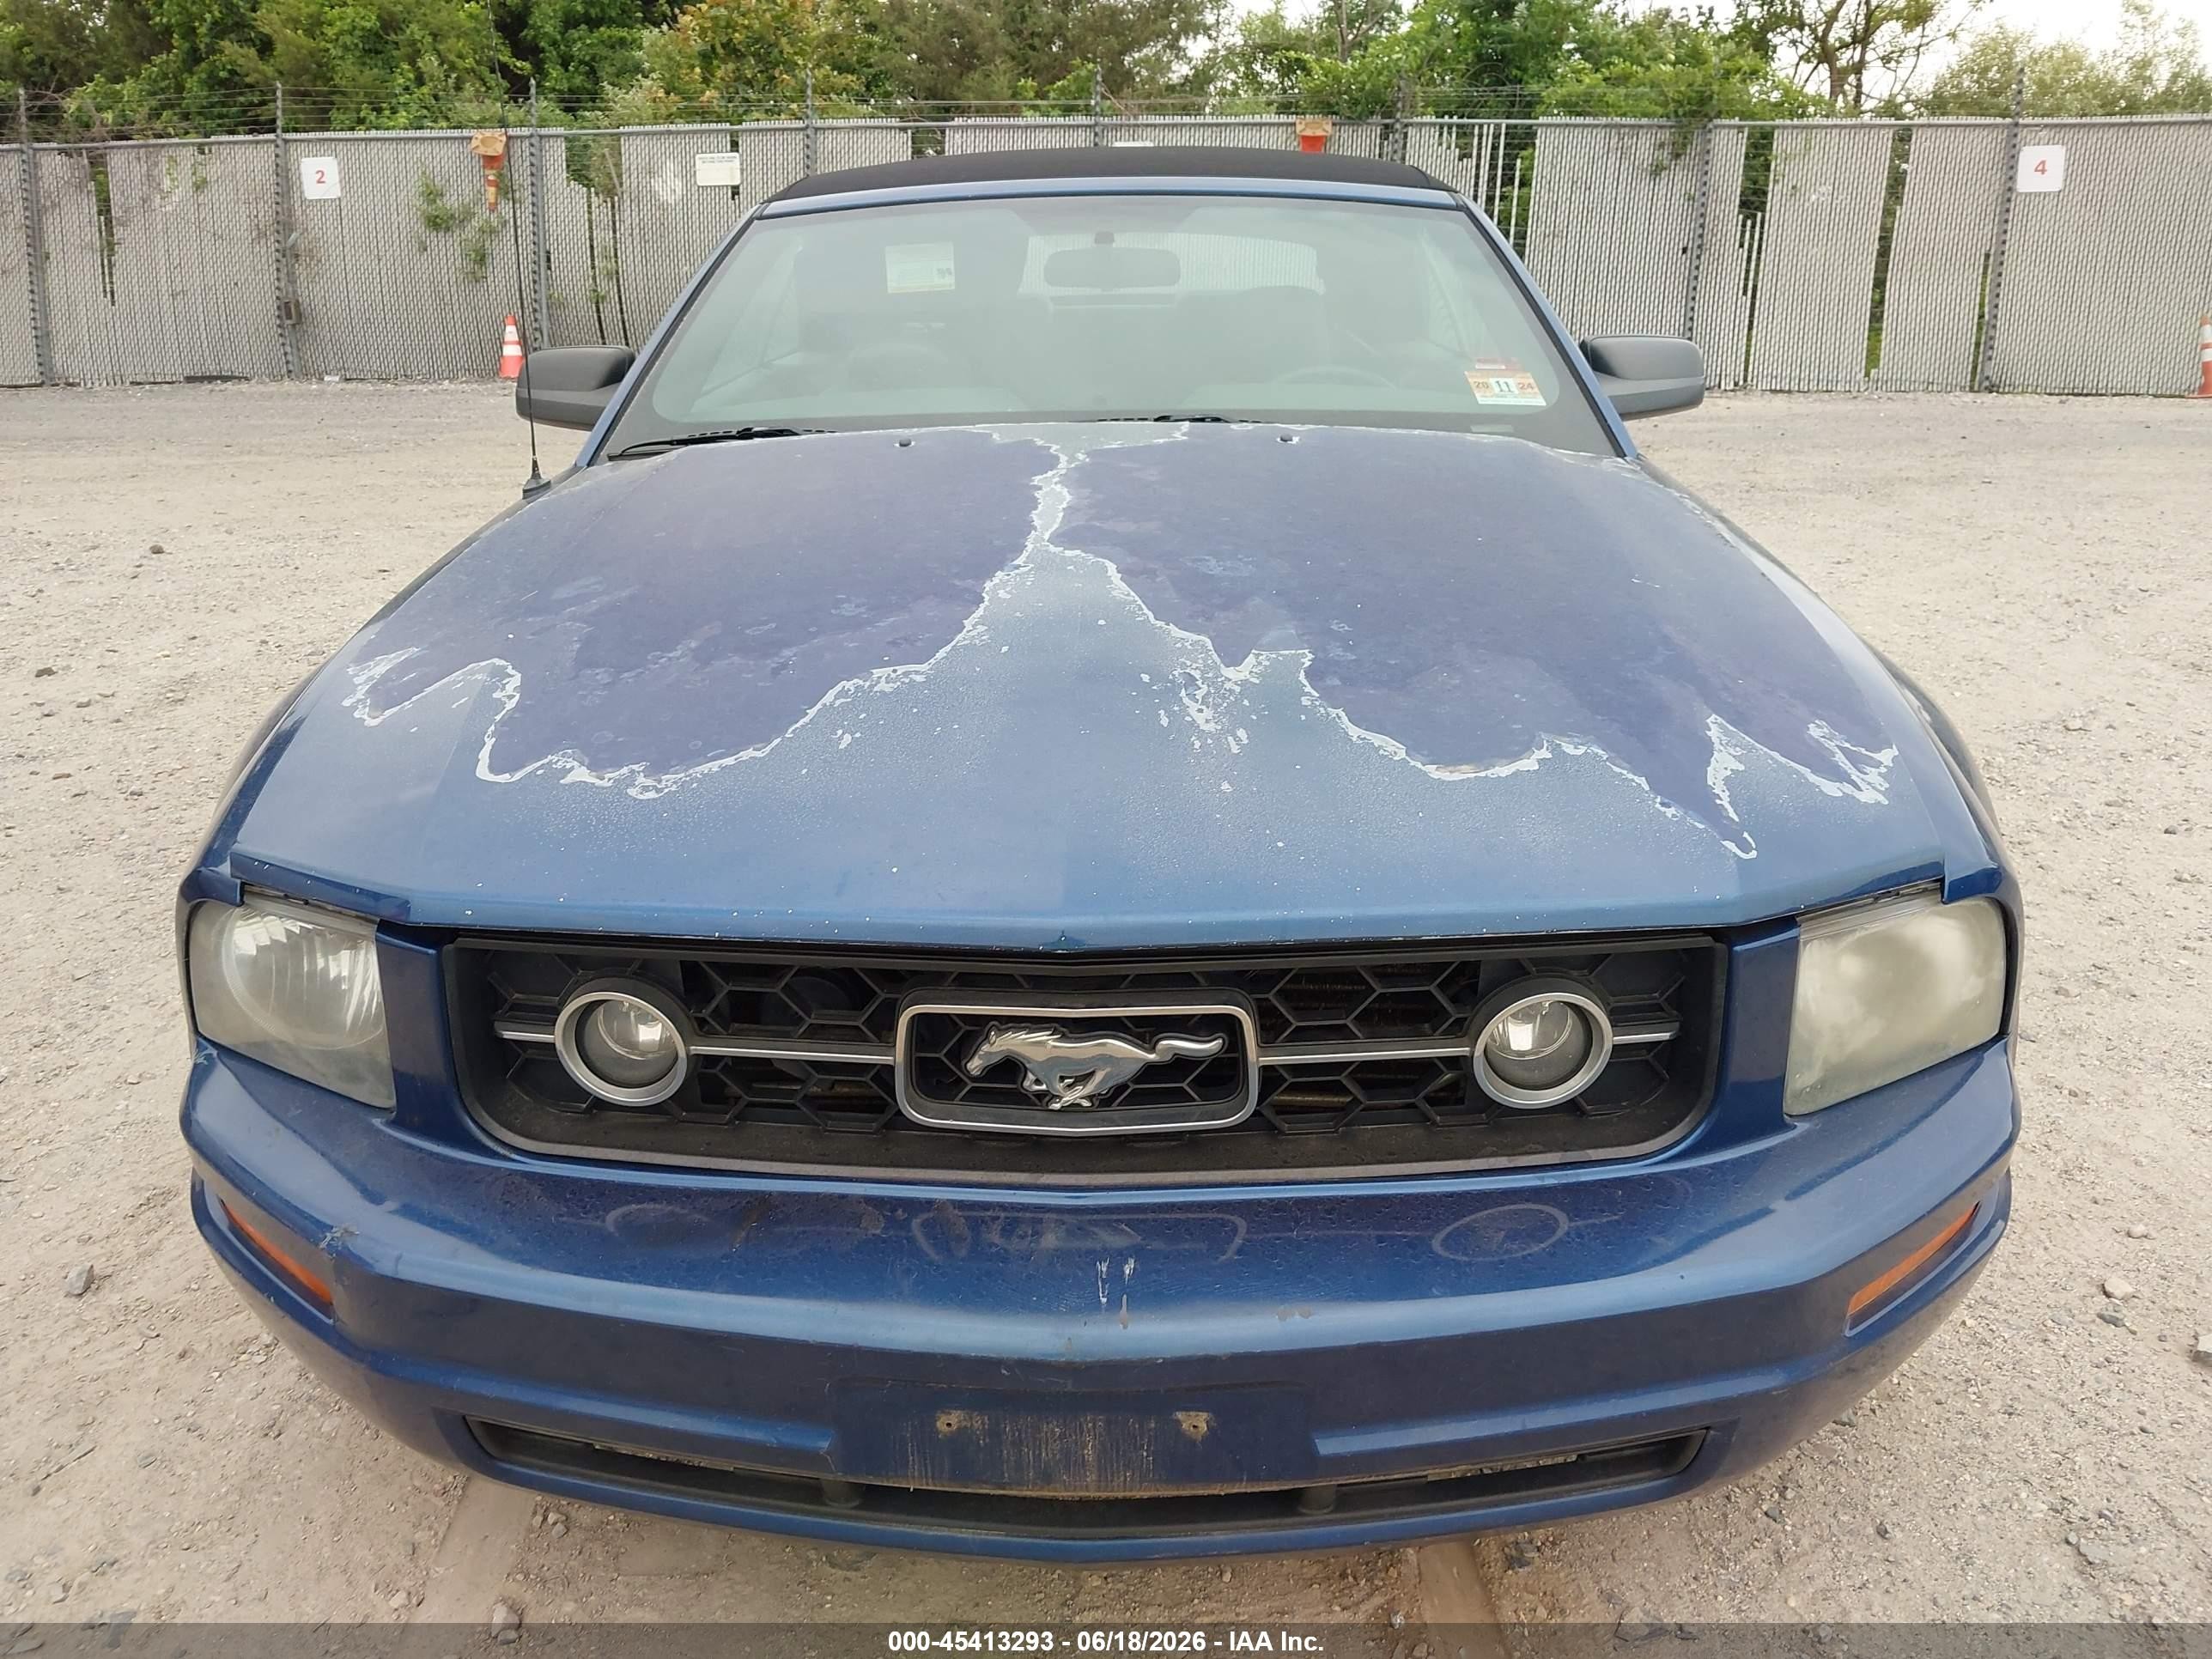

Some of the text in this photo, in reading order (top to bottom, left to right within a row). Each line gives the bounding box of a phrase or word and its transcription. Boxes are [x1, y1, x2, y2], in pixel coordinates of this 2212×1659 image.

[2034, 160, 2048, 175] 4
[315, 170, 326, 185] 2
[1495, 380, 1514, 393] 11
